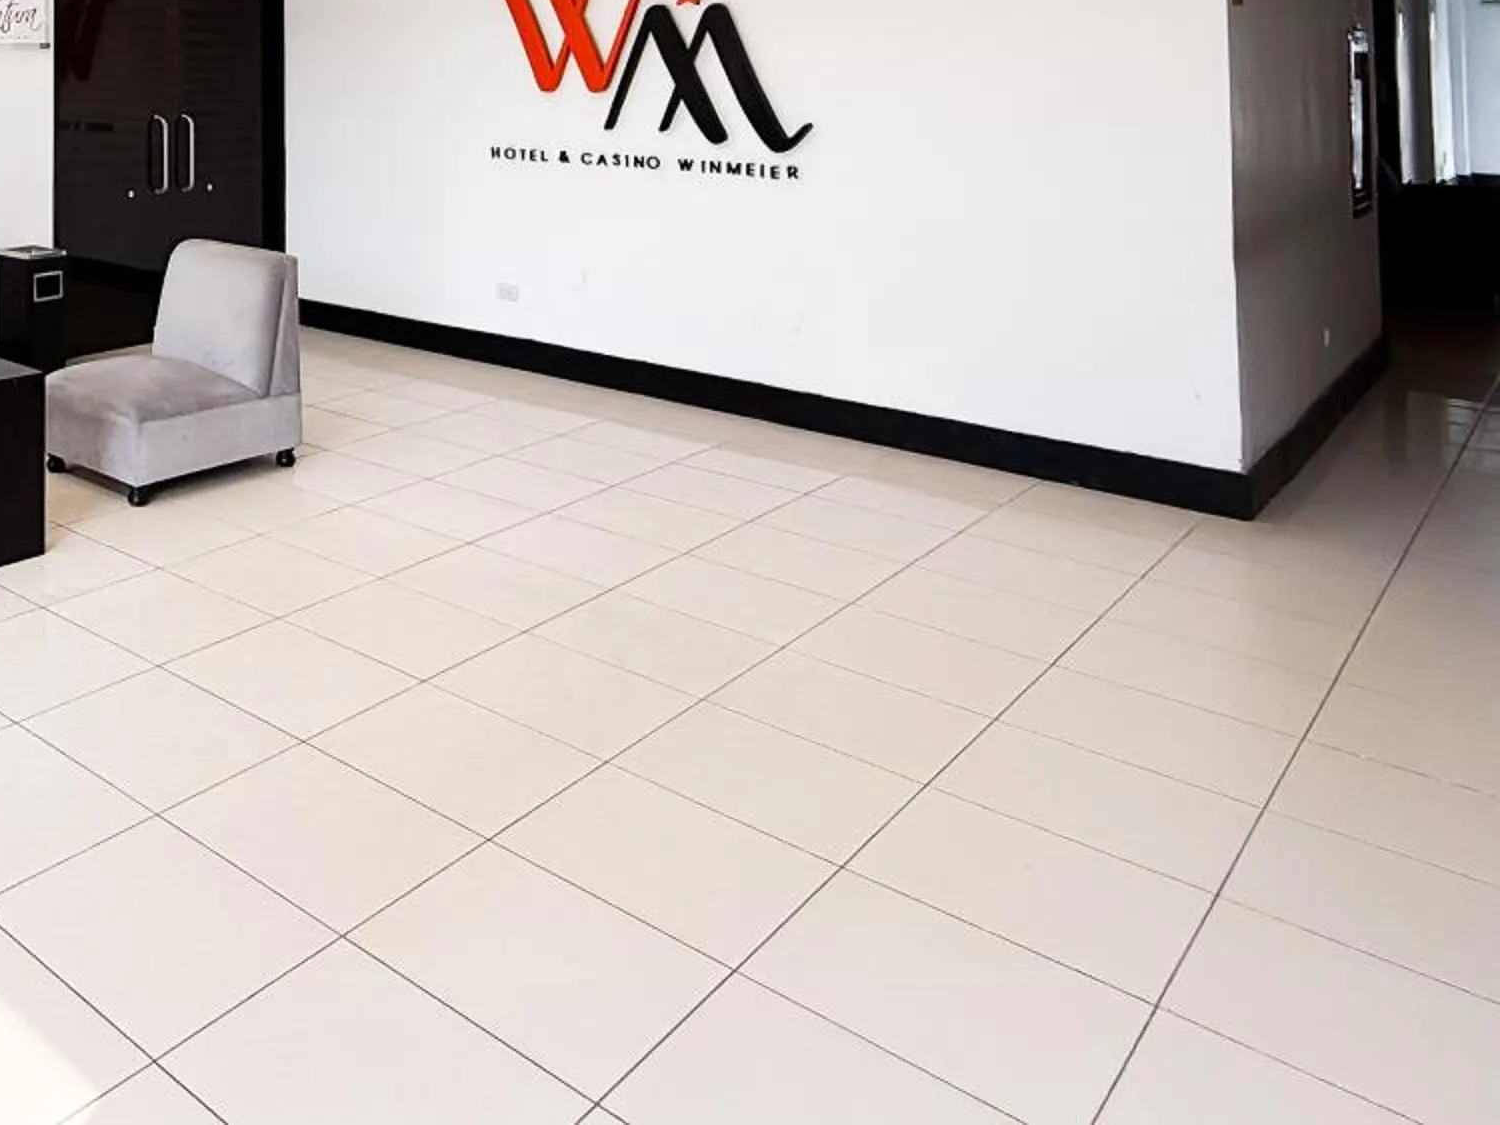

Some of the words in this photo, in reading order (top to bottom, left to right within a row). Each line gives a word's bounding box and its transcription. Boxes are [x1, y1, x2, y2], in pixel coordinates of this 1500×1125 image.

[490, 146, 549, 162] HOTEL
[558, 150, 571, 164] &
[580, 152, 661, 170] CASINO
[677, 158, 800, 180] WINMEIER
